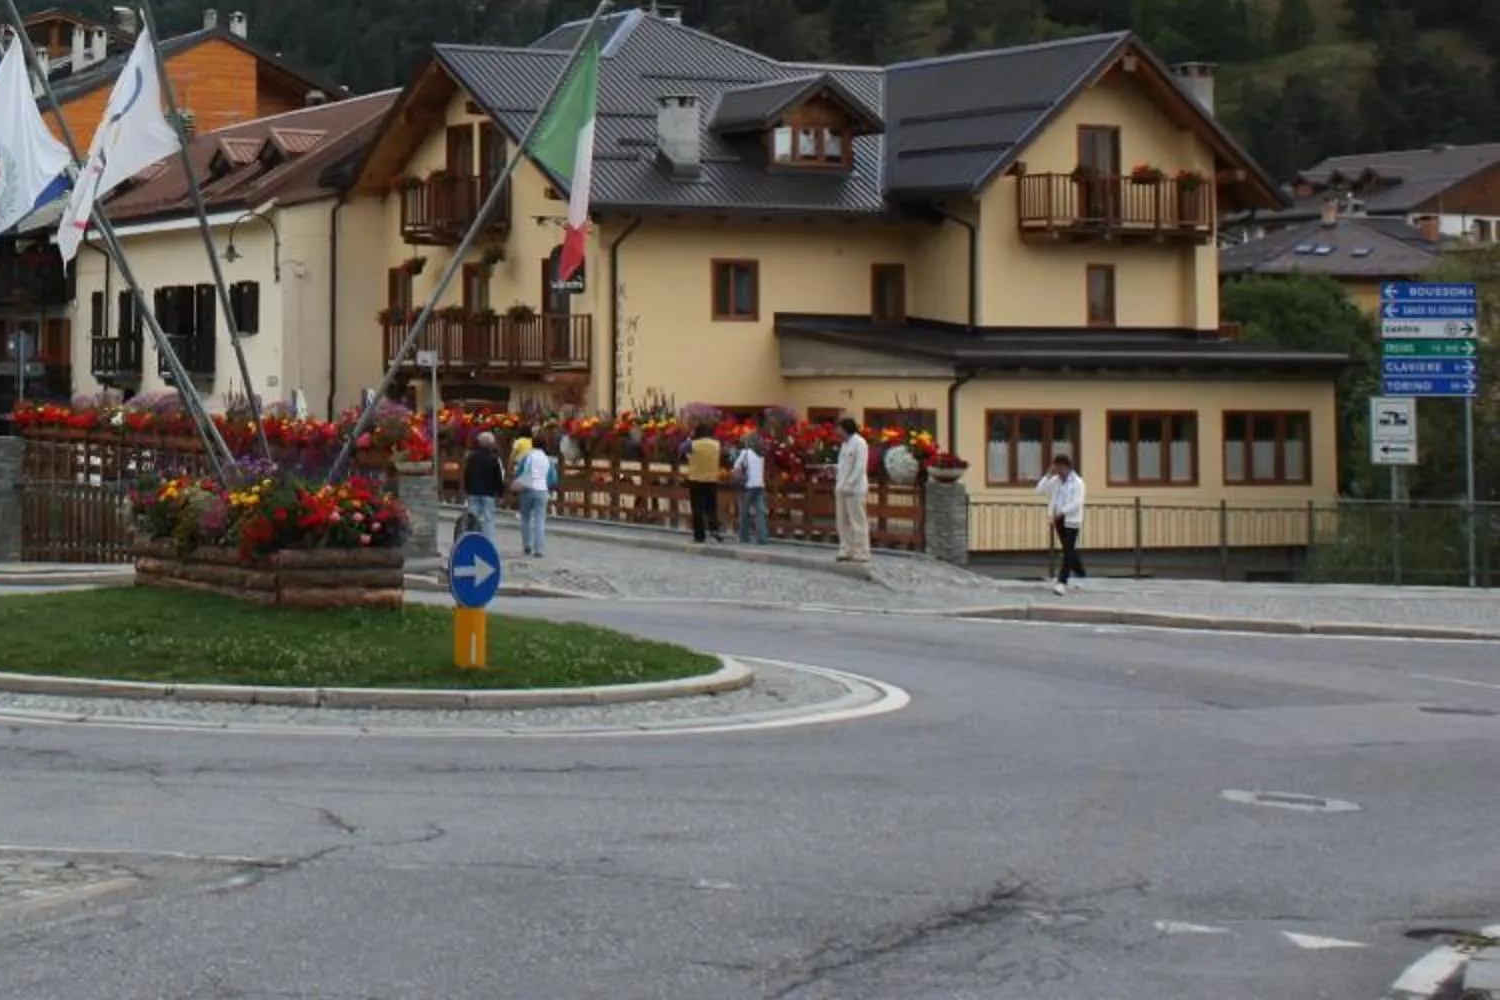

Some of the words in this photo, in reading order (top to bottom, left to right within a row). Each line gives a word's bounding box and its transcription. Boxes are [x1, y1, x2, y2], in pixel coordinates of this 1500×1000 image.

[1409, 287, 1467, 297] BOUSSON
[1385, 362, 1442, 373] CLAVIERE
[1387, 381, 1432, 392] TORINO
